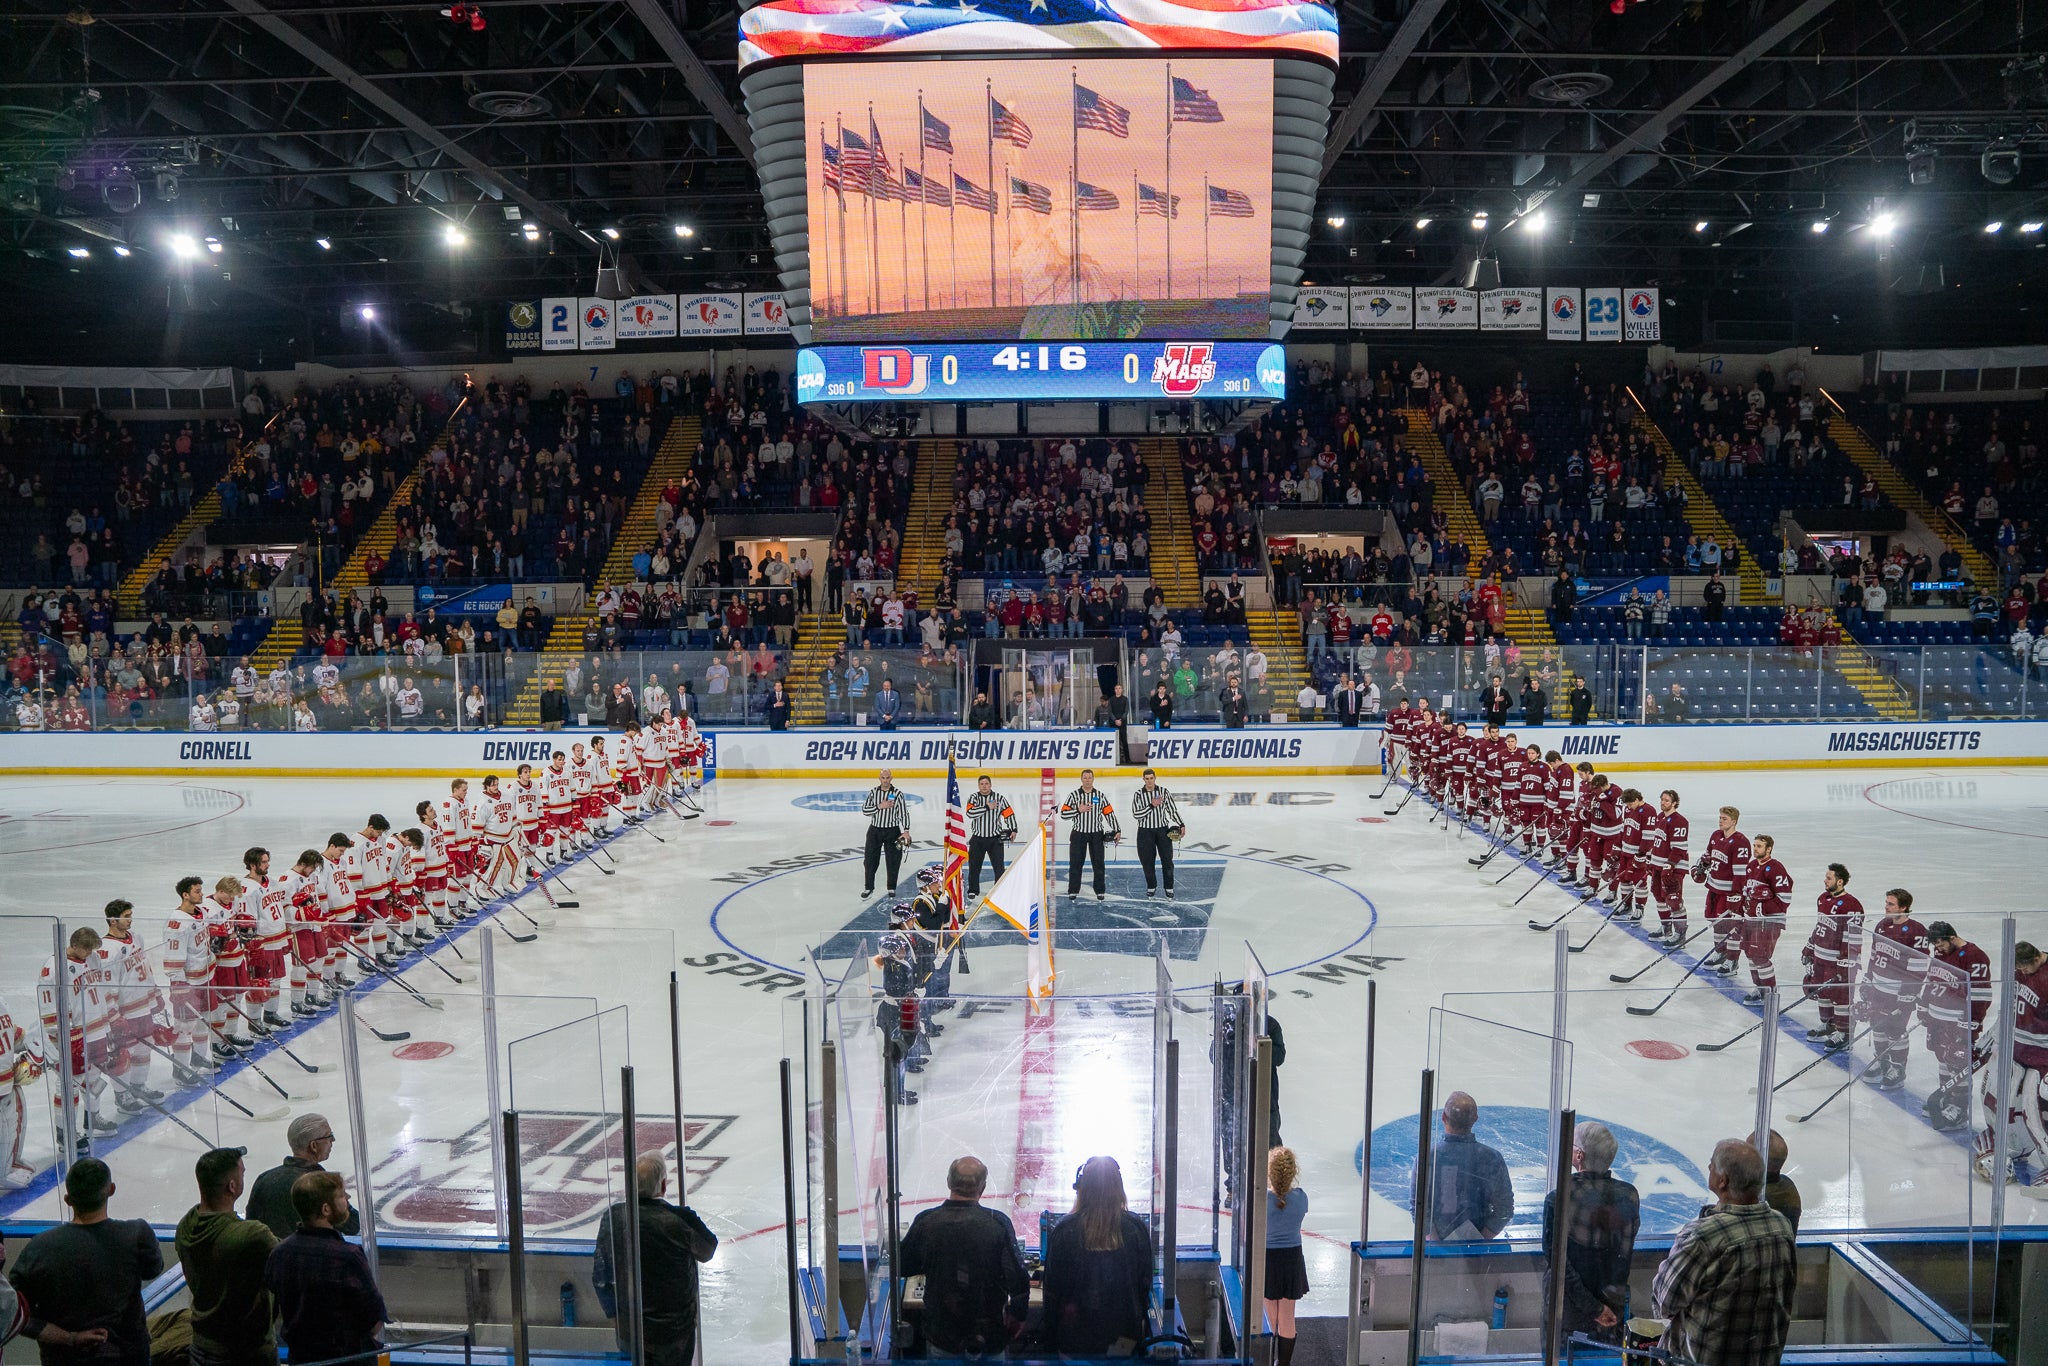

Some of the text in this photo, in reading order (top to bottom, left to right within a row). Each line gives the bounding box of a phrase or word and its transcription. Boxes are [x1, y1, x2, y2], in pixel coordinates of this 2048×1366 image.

[1322, 289, 1348, 299] FALCONS
[1351, 290, 1412, 300] SPRINGFIELD FALCONS
[1417, 290, 1476, 299] SPRINGFIELD FALCONS
[1480, 290, 1542, 299] SPRINGFIELD FALCONS
[620, 298, 674, 312] SPRINGFIELD INDIANS
[684, 297, 738, 310] SPRINGFIELD INDIANS
[748, 294, 781, 308] SPRINGFIELD
[1588, 297, 1619, 323] 23
[552, 305, 568, 332] 2
[1626, 322, 1658, 330] WILLIE
[506, 332, 540, 340] BRUCE
[1626, 330, 1658, 338] O'REE
[506, 340, 540, 348] LANDON
[992, 346, 1087, 370] 4:16
[942, 355, 958, 385] 0
[1124, 354, 1139, 384] 0
[1710, 360, 1723, 374] 12
[590, 366, 598, 382] 7
[828, 382, 854, 395] SOG 0
[1224, 378, 1250, 392] SOG 0
[1770, 583, 1778, 592] 11
[262, 594, 268, 602] 6
[542, 592, 546, 600] 7
[464, 601, 476, 610] ICE
[1561, 736, 1620, 755] MAINE
[1828, 731, 1981, 752] MASSACHUSETTS
[180, 742, 251, 760] CORNELL
[483, 742, 552, 760] DENVER
[806, 741, 857, 760] 2024
[862, 741, 911, 760] NCAA
[1008, 740, 1014, 760] I
[1019, 740, 1079, 760] MEN'S
[1084, 740, 1114, 759] ICE
[1197, 740, 1302, 758] REGIONALS
[550, 779, 570, 789] DENVER
[580, 779, 584, 787] 7
[1526, 782, 1534, 790] 14
[560, 788, 564, 796] 9
[528, 803, 532, 812] 2
[498, 812, 508, 824] 35
[1647, 816, 1656, 826] 15
[1674, 828, 1686, 836] 20
[1738, 848, 1748, 858] 23
[348, 856, 354, 864] 8
[1710, 860, 1719, 871] 23
[1776, 876, 1789, 886] 24
[270, 904, 282, 921] 21
[1830, 906, 1837, 914] C
[1816, 926, 1826, 937] 25
[170, 940, 180, 950] 18
[1914, 936, 1928, 948] 26
[1875, 955, 1888, 968] 26
[1295, 954, 1406, 985] MA
[1972, 964, 1988, 978] 27
[88, 988, 100, 1005] 11
[1931, 984, 1946, 997] 27
[42, 990, 52, 1004] 11
